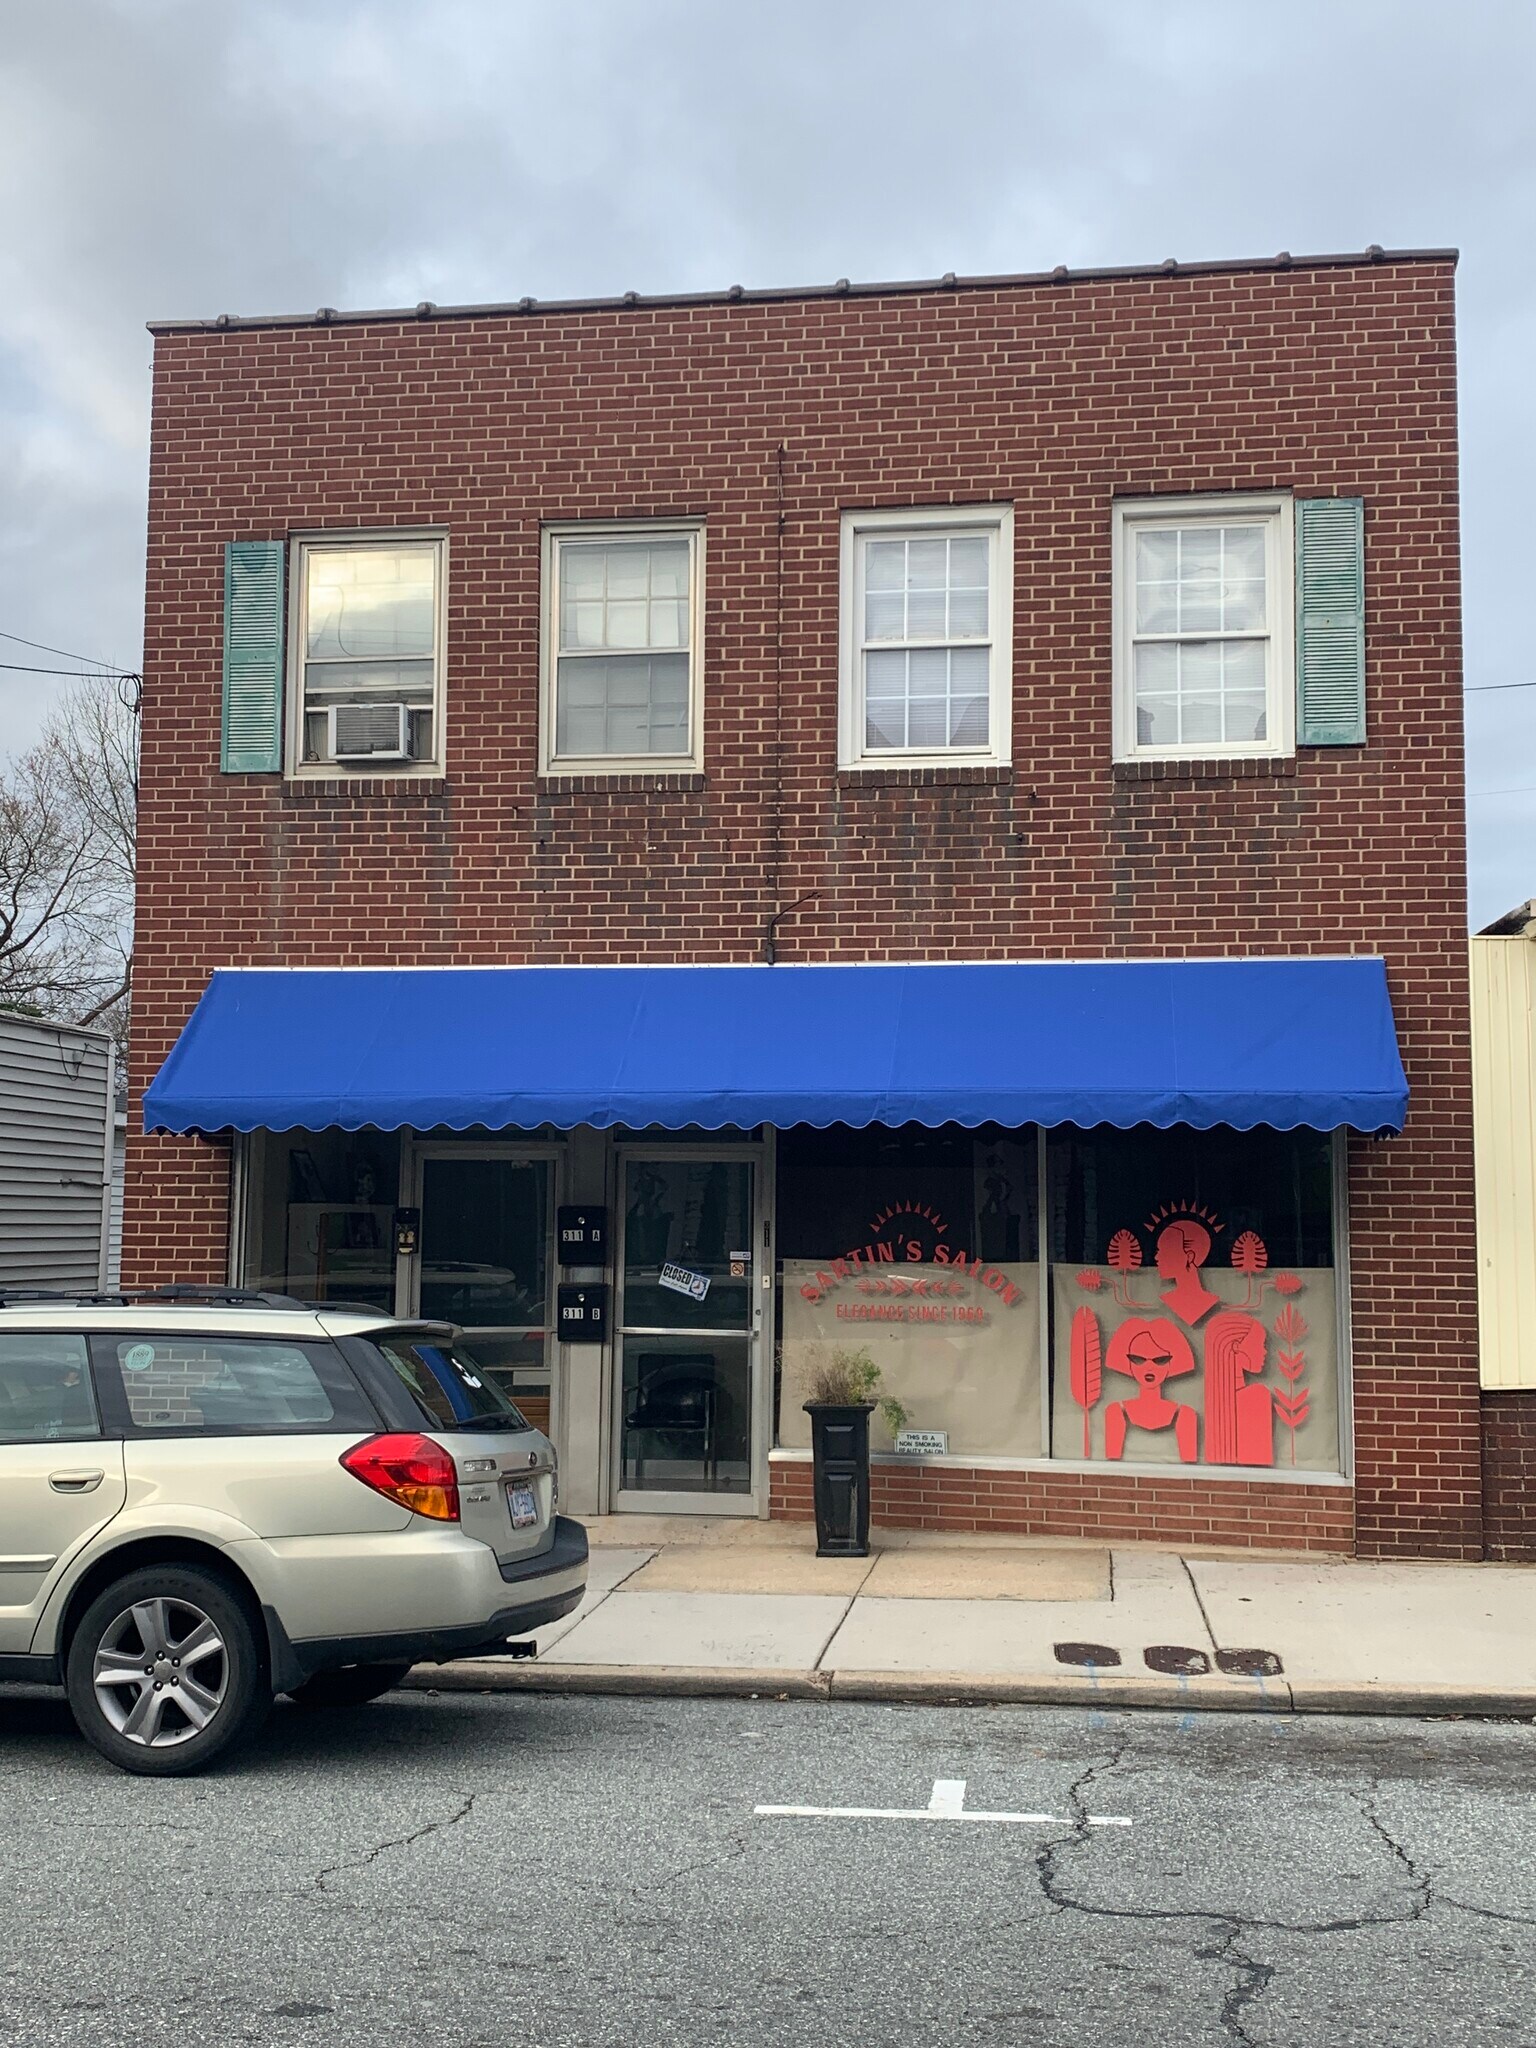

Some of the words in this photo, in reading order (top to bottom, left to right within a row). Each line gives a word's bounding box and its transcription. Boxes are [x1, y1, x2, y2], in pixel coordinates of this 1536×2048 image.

[564, 1230, 582, 1241] 311
[593, 1230, 599, 1241] A
[662, 1265, 693, 1285] CLOSED
[800, 1234, 922, 1304] SARTIN'S
[934, 1245, 1024, 1306] SALON
[564, 1308, 582, 1319] 311
[593, 1308, 599, 1319] B
[836, 1304, 904, 1320] ELEGANCE
[908, 1306, 947, 1321] SINCE
